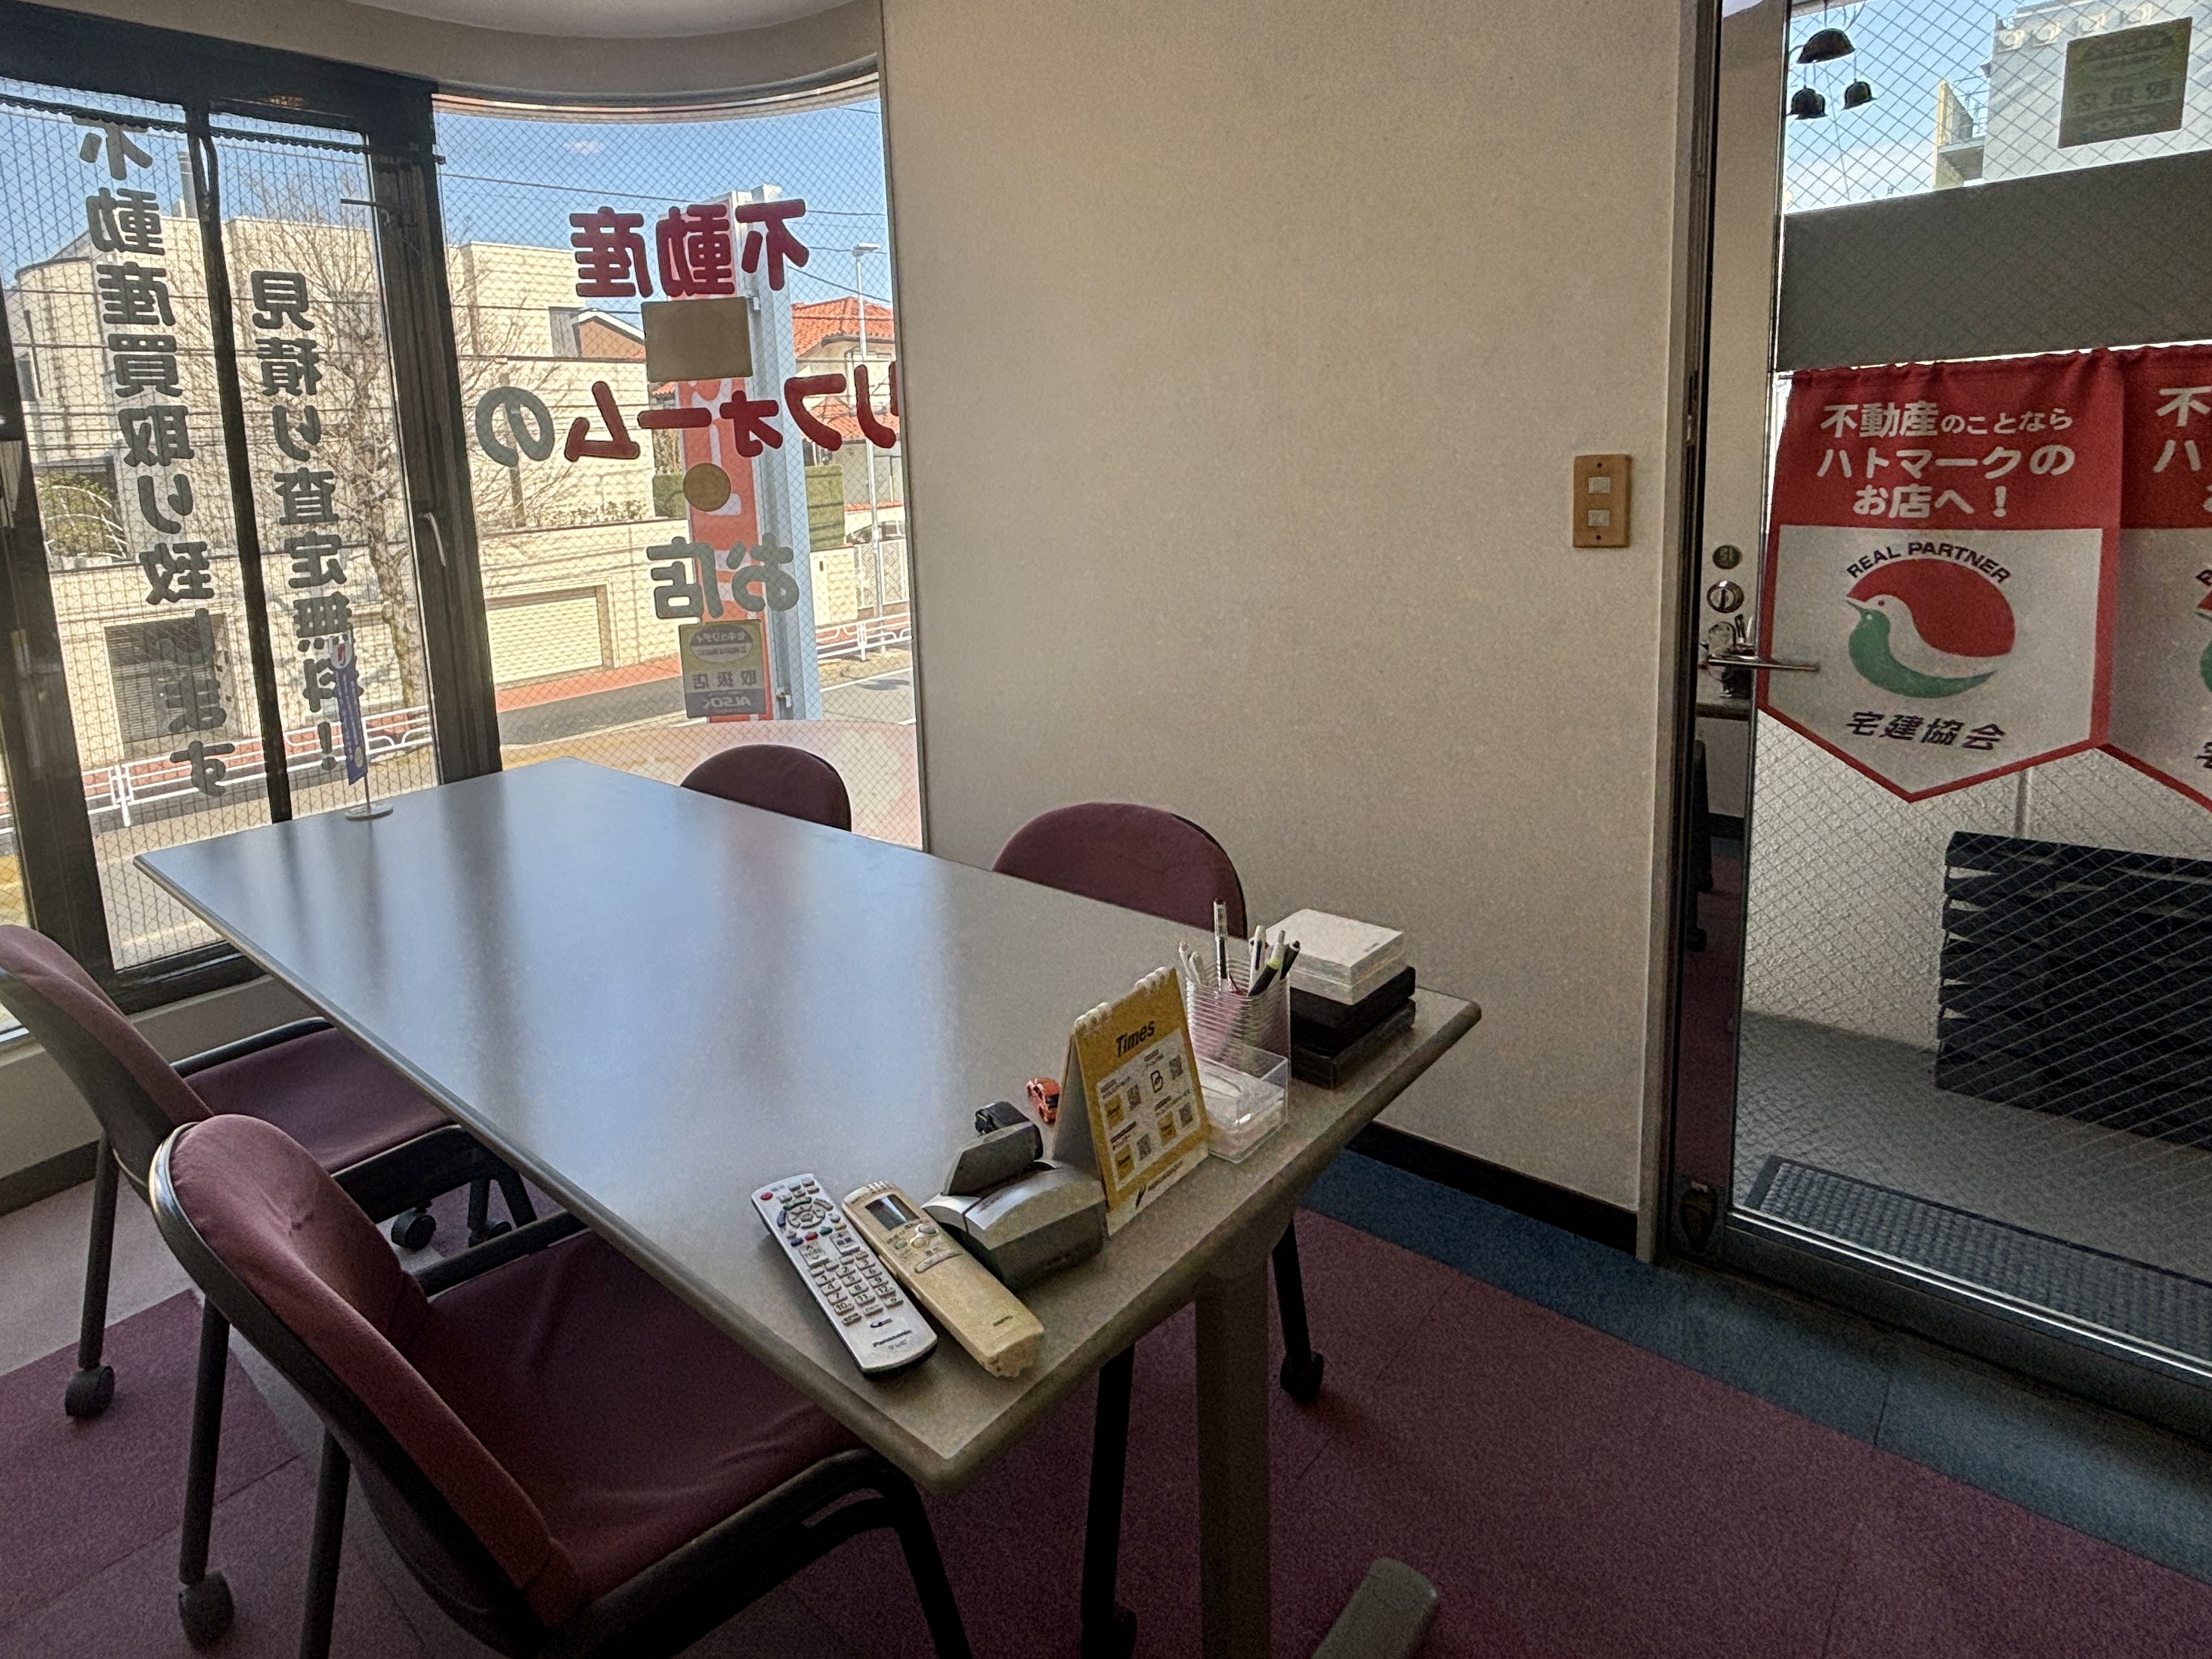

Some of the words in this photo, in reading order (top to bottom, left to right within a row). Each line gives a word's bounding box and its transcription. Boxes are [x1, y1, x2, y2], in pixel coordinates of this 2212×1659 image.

[1820, 400, 2074, 438] 不動産のことなら
[1817, 444, 2075, 480] ハトマークの
[1846, 545, 1901, 578] REAL
[1908, 541, 2012, 584] PARTNER
[1845, 710, 2006, 752] 宅建協会
[1115, 1020, 1155, 1058] Times
[872, 1329, 913, 1348] Panasonic
